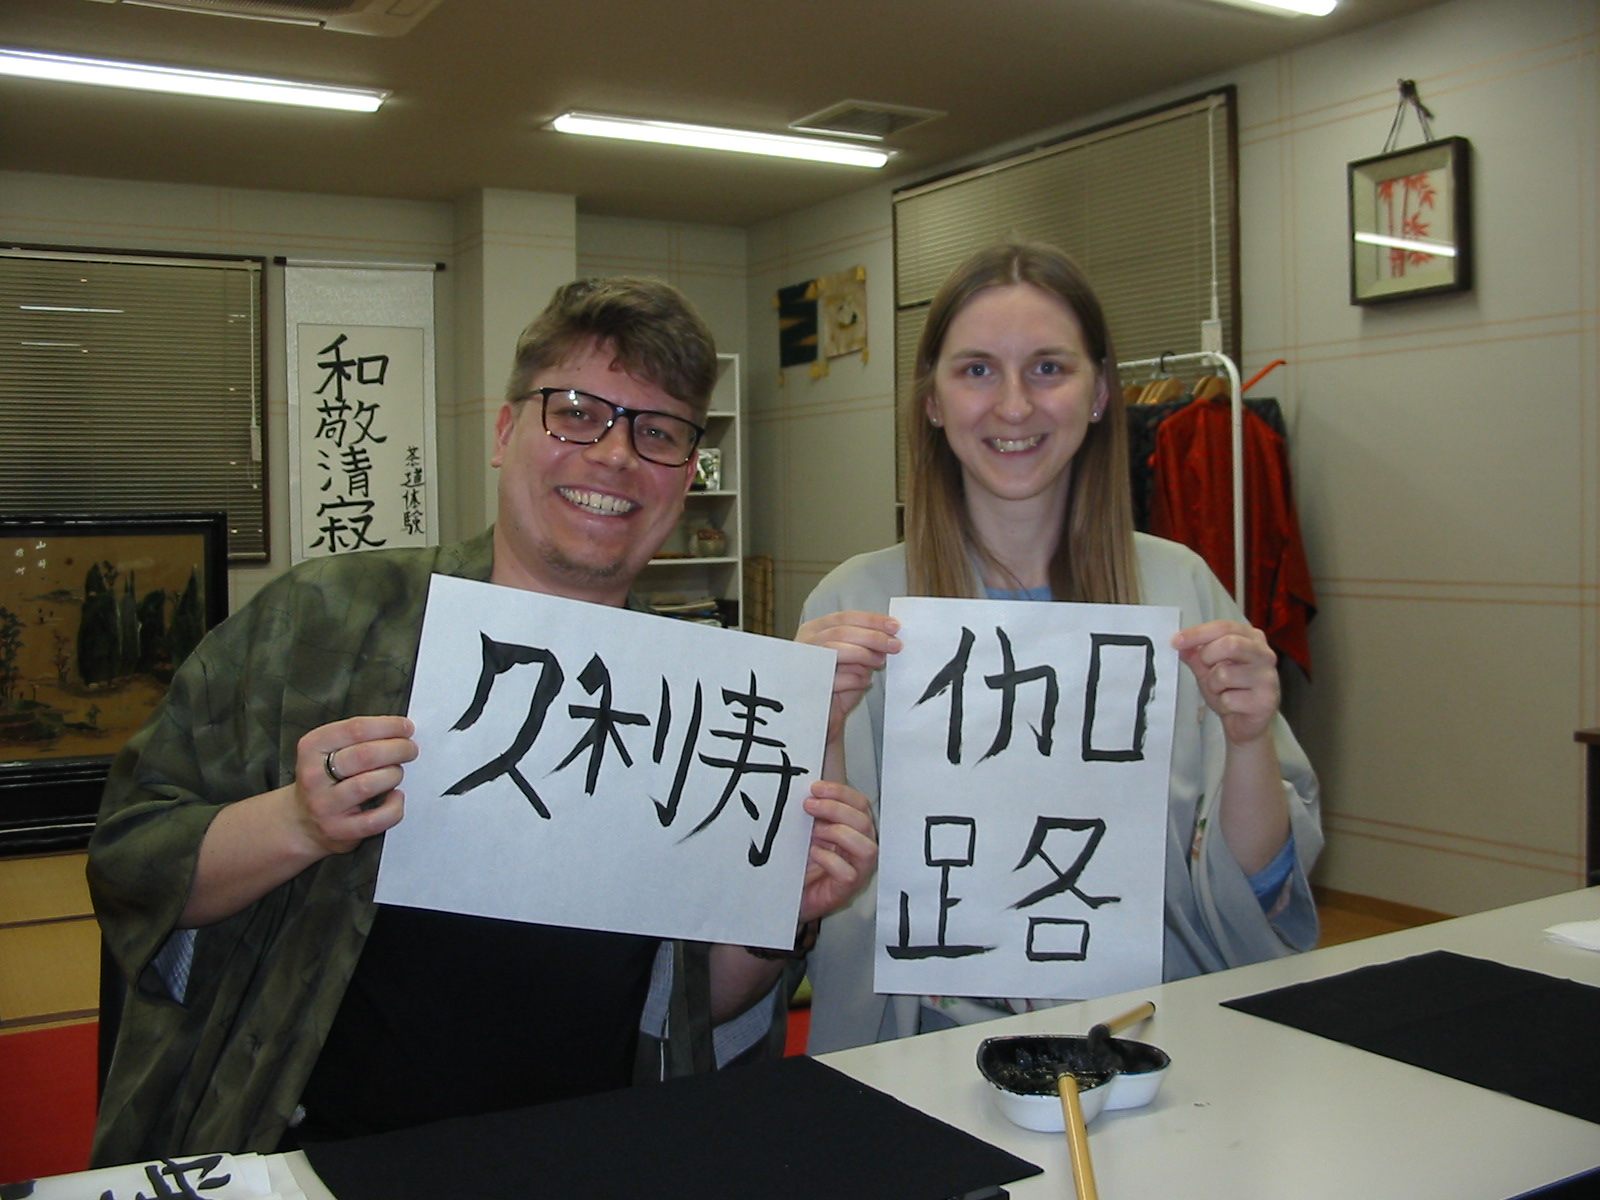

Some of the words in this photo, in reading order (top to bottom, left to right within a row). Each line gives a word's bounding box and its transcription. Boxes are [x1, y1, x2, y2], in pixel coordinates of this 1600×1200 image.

[309, 334, 389, 552] 和敬清寂
[441, 630, 809, 867] 久利寿
[886, 626, 1157, 962] 伽路
